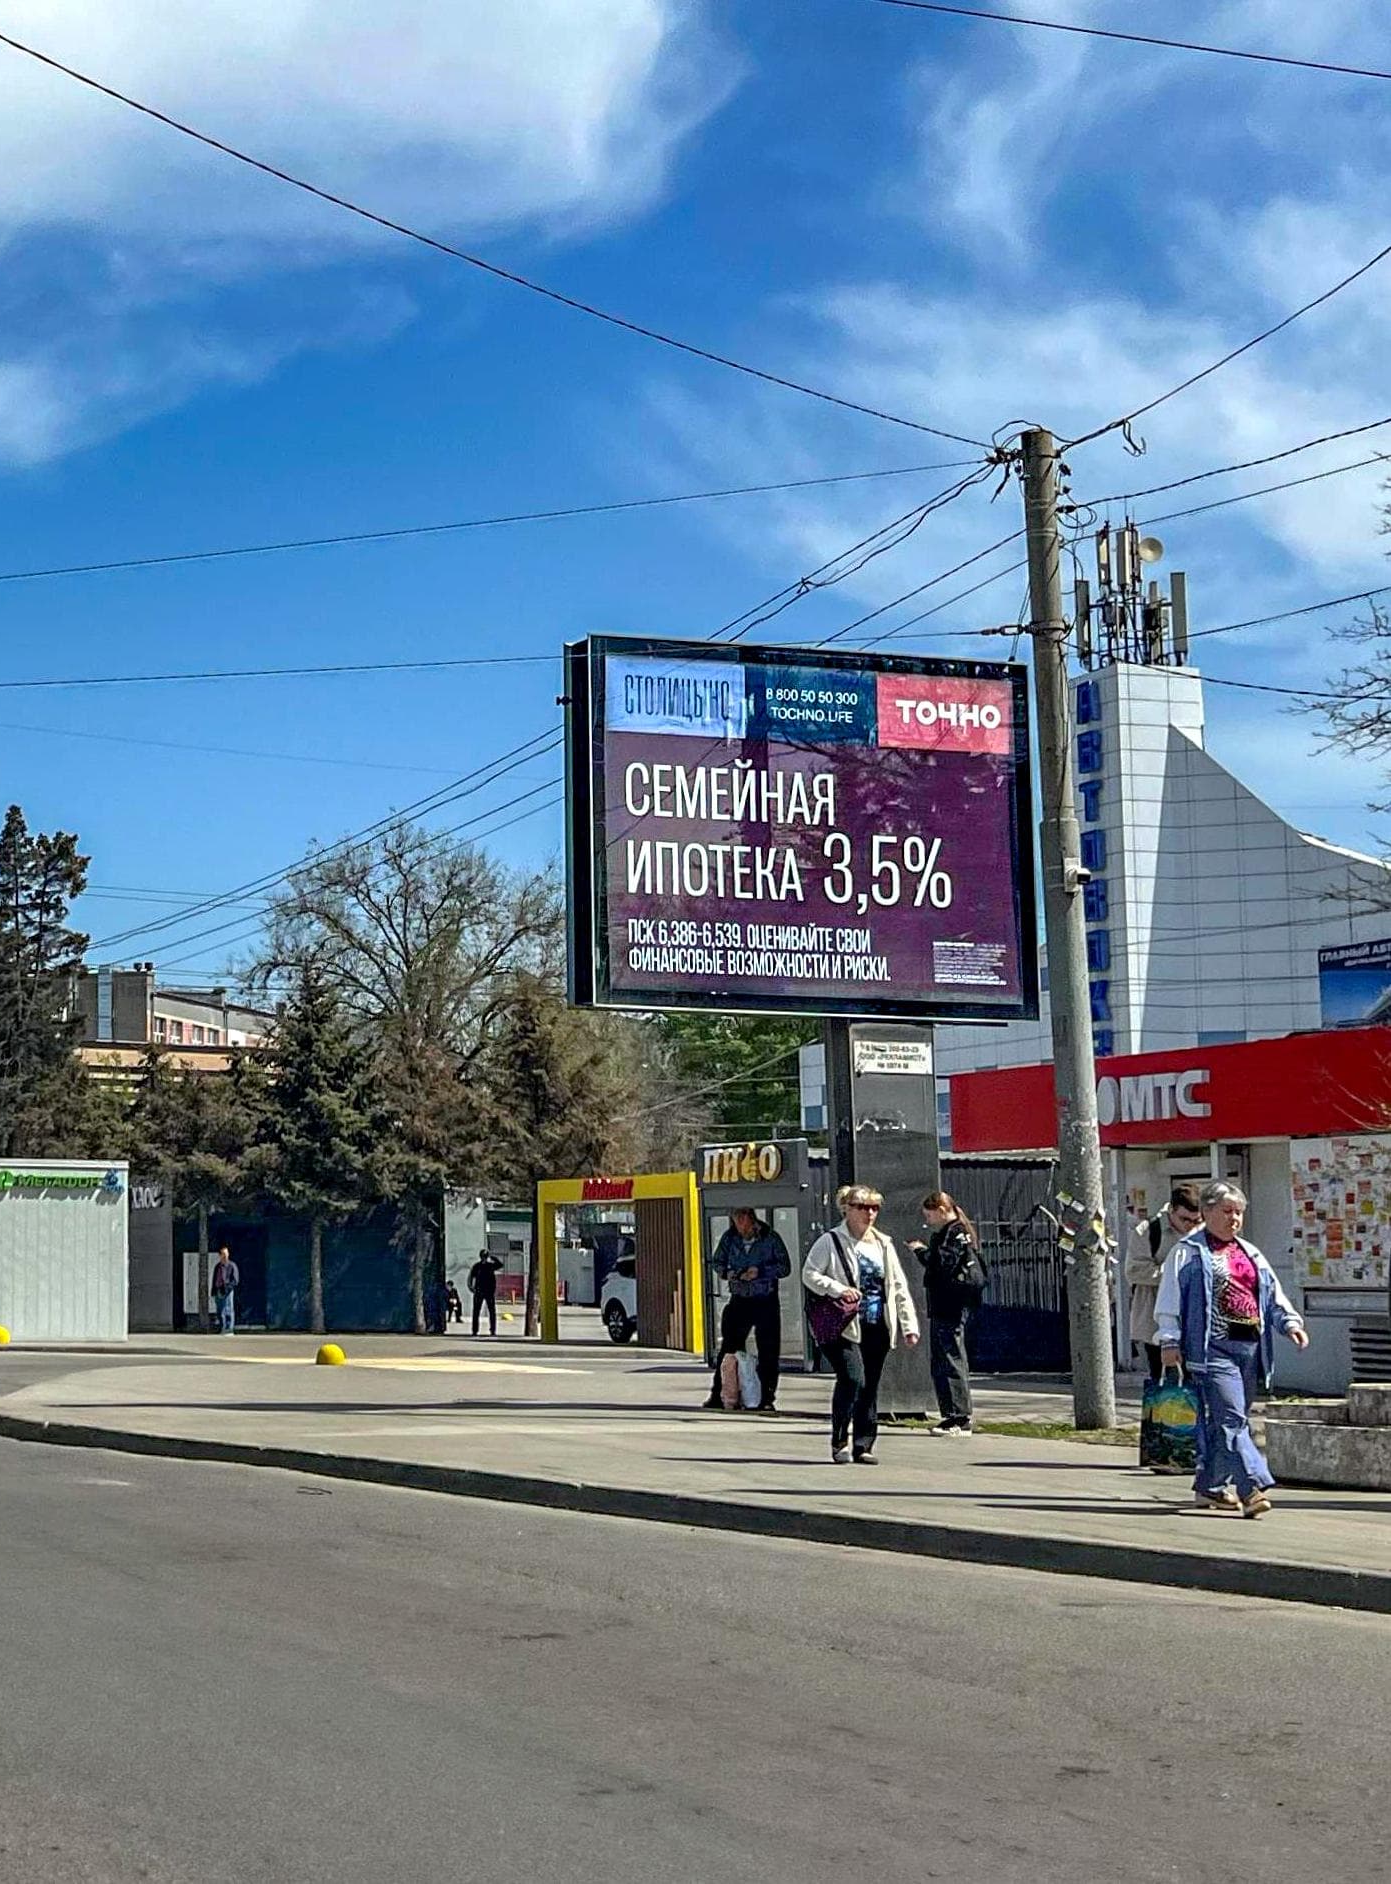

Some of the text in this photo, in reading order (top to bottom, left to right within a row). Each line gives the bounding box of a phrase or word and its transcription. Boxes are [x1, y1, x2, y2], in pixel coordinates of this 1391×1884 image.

[765, 688, 858, 705] 8 800 50 50 300
[895, 699, 1002, 729] ТОЧНО
[771, 707, 854, 724] TOCHNO.LIFE
[625, 758, 835, 827] СЕМЕЙНАЯ
[627, 832, 953, 915] ИПОТЕКА 3,5%
[628, 918, 871, 954] ПСК 6,386-6,539. ОЦЕНИВАЙТЕ СВОИ
[628, 947, 892, 981] ФИНАНСОВЫЕ ВОЗМОЖНОСТИ И РИСКИ.
[1120, 1069, 1211, 1123] МТС
